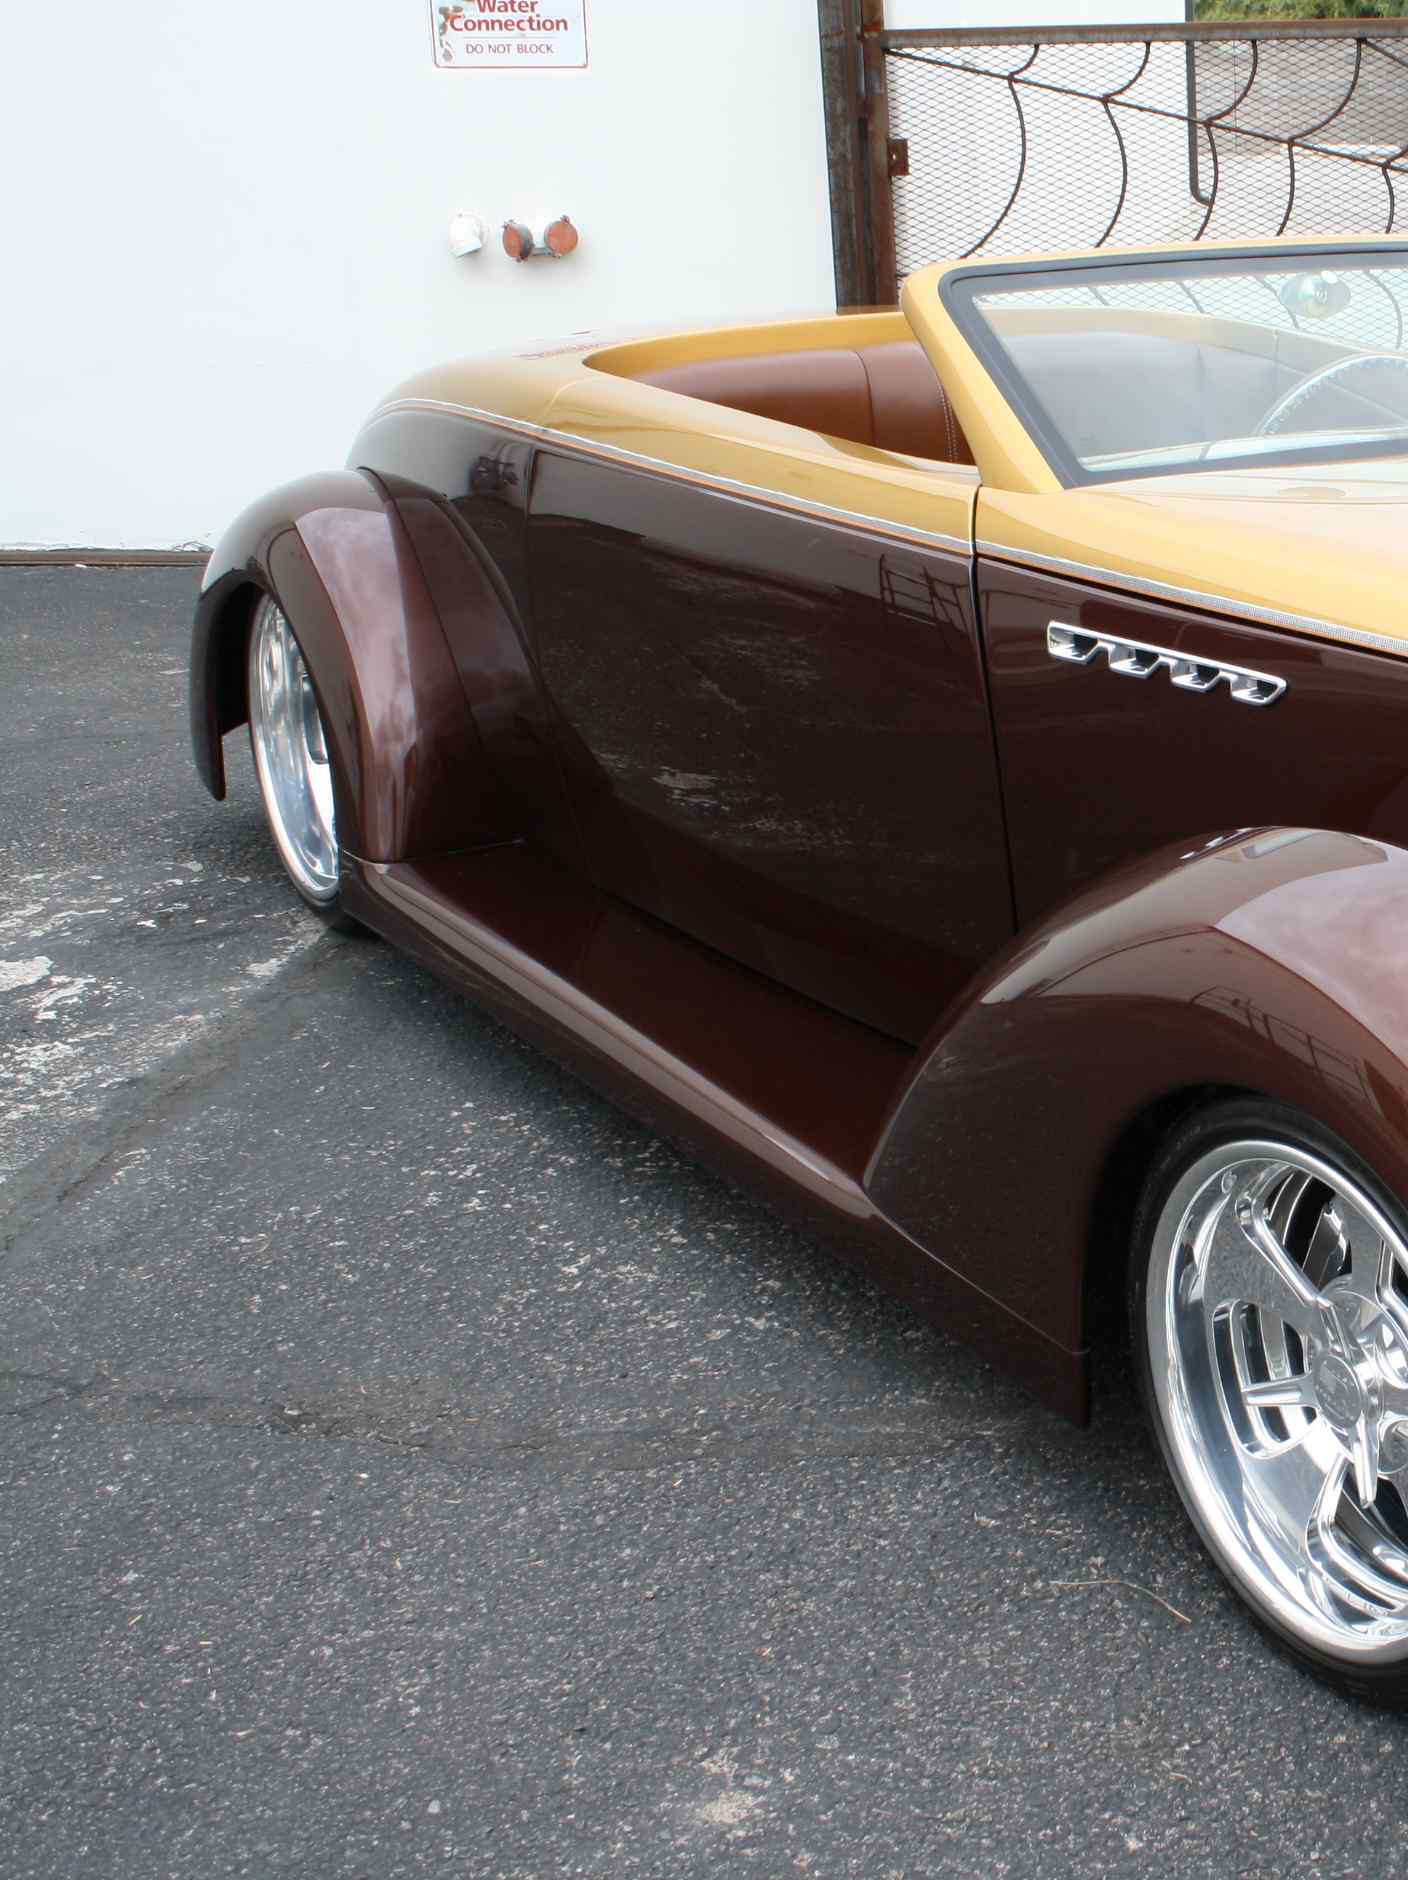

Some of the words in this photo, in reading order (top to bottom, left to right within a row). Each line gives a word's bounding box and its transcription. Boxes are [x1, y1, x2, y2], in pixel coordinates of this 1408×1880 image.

[477, 0, 538, 13] Water
[450, 14, 568, 31] Connection
[466, 44, 483, 54] DO
[488, 44, 512, 54] NOT
[517, 44, 554, 54] BLOCK
